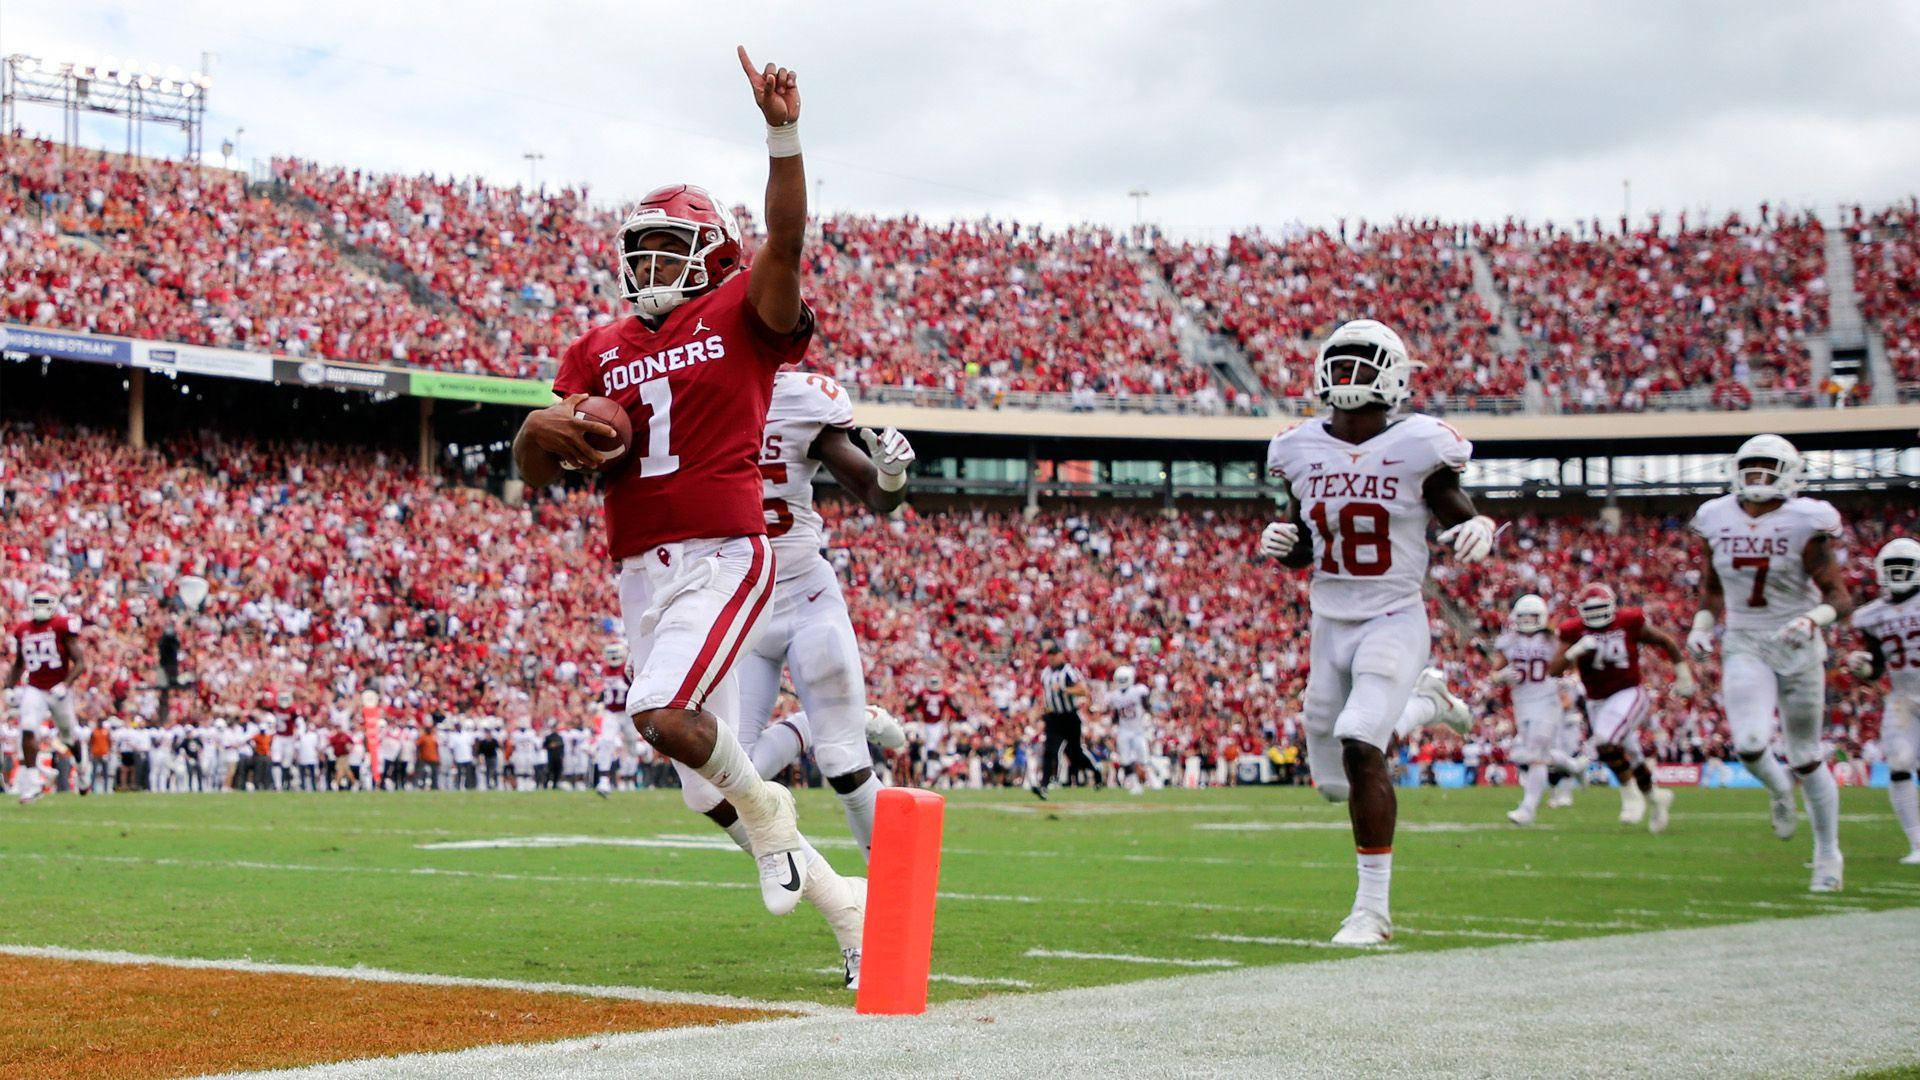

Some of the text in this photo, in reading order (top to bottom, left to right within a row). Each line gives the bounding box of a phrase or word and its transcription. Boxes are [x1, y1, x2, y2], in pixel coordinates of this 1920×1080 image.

[603, 335, 725, 396] SOONERS
[639, 376, 680, 478] 1
[1309, 473, 1398, 500] TEXAS
[1310, 502, 1392, 576] 18
[1720, 537, 1789, 555] TEXAS
[1732, 557, 1769, 607] 7
